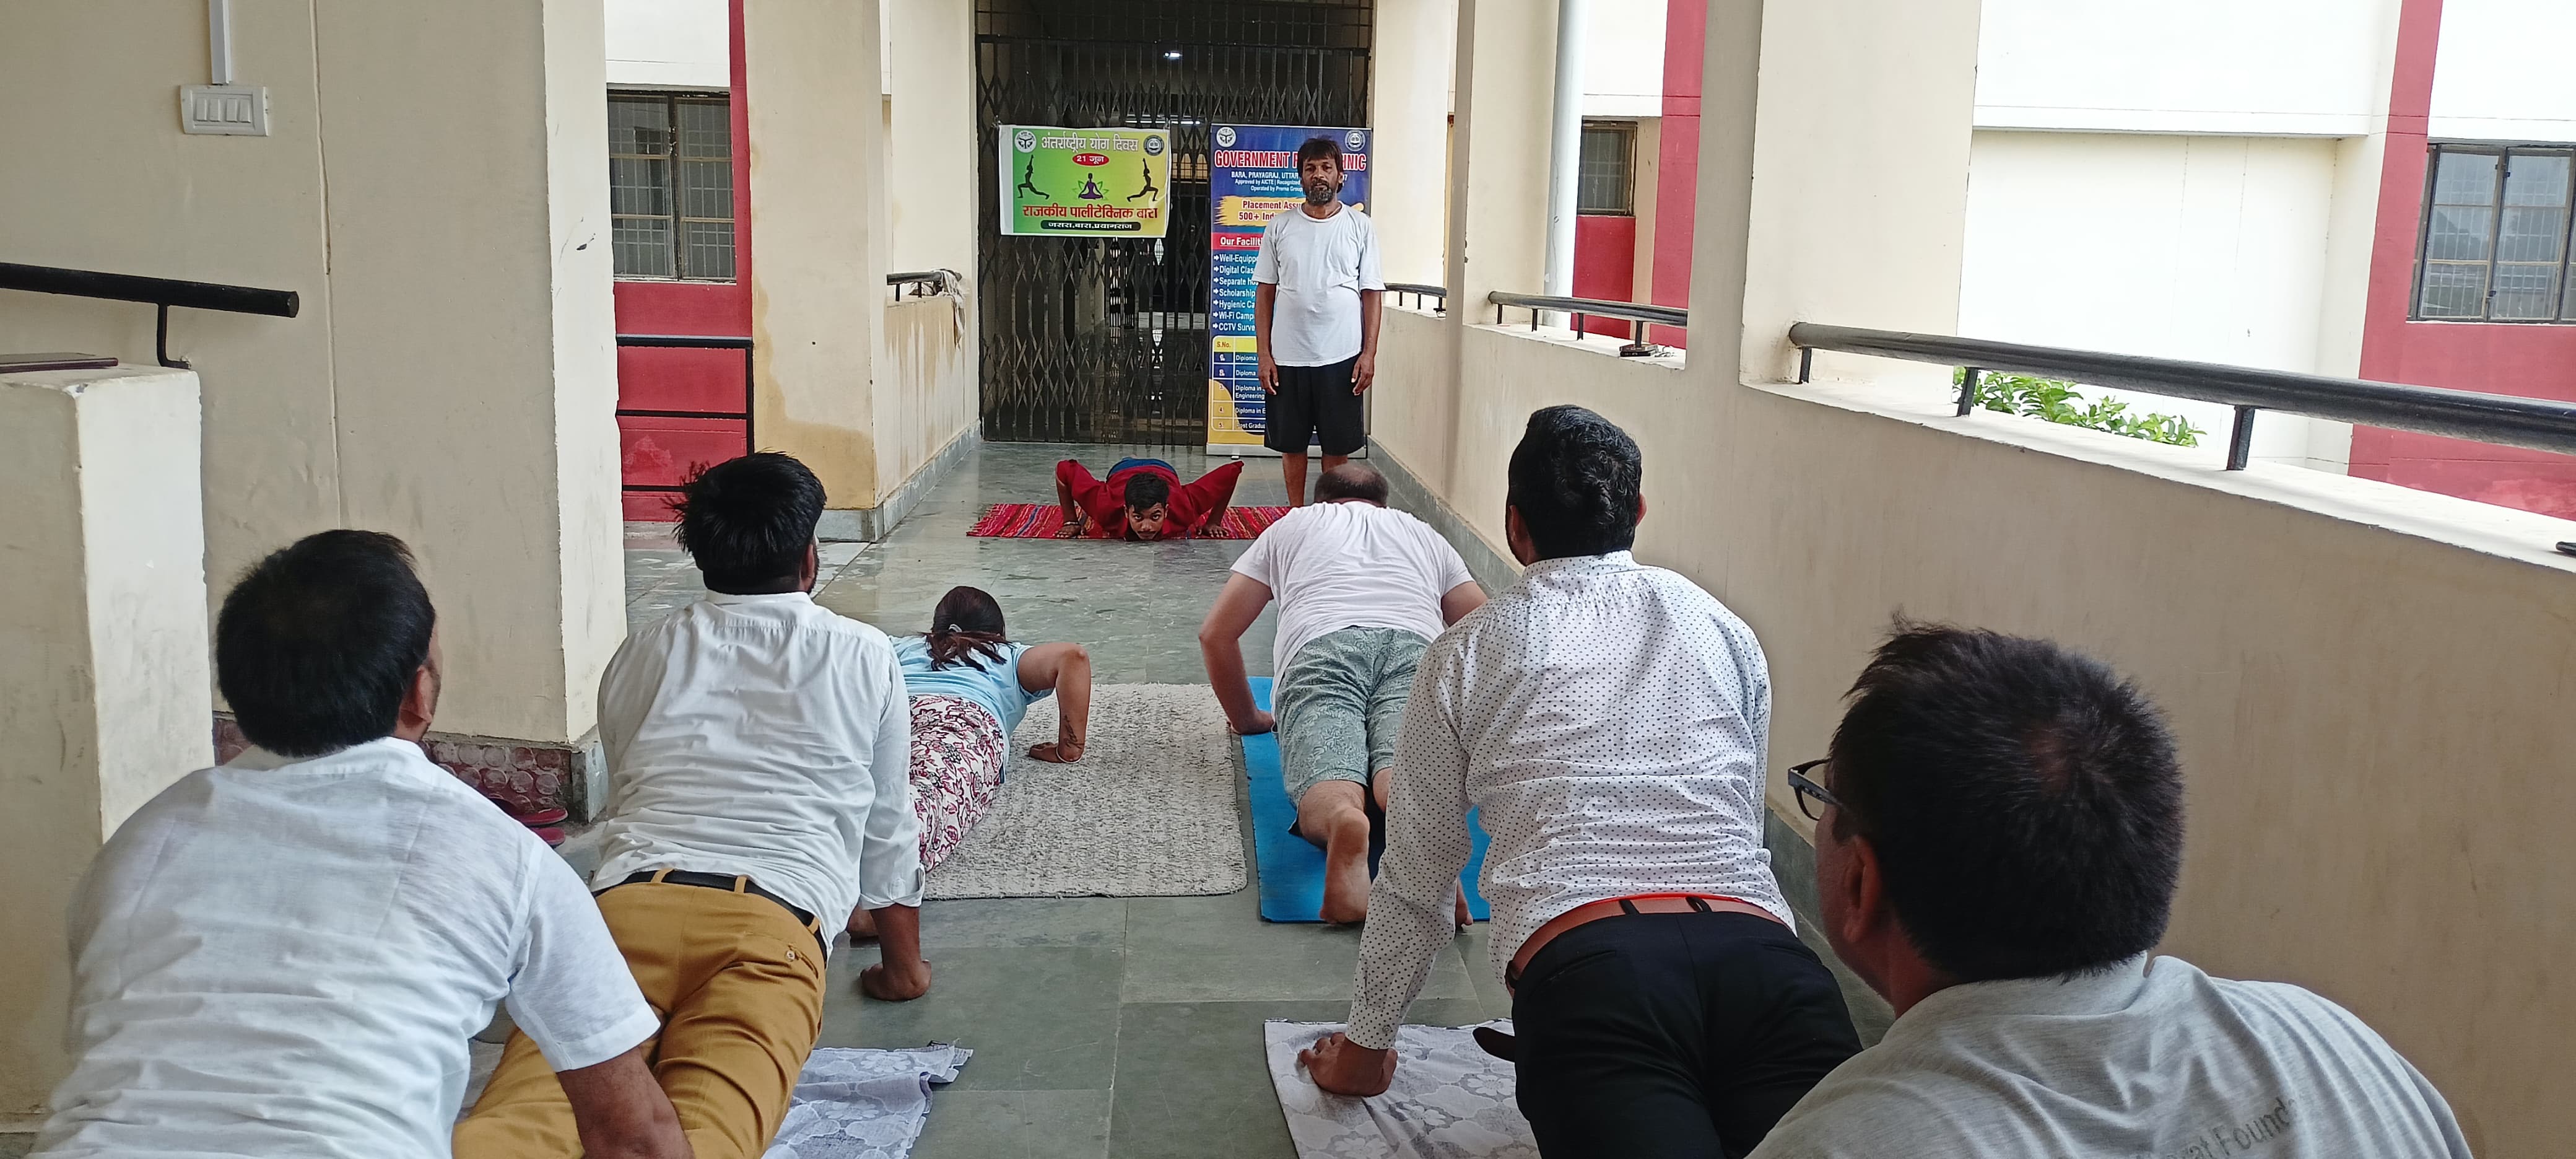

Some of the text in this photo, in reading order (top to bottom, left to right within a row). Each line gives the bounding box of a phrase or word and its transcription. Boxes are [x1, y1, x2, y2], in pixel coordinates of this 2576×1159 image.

[1090, 132, 1110, 150] योग
[1113, 133, 1139, 151] दिवस
[1089, 155, 1104, 164] जून
[1215, 150, 1290, 168] GOVERNMENT
[1243, 200, 1281, 209] Placement
[1023, 203, 1067, 217] राजकीय
[1136, 208, 1158, 219] बारा
[1238, 212, 1260, 221] 500+
[1221, 237, 1234, 245] Our
[1219, 253, 1258, 264] Well-Equipp
[1219, 265, 1239, 276] Digital
[1219, 277, 1246, 287] Separate
[1219, 300, 1245, 310] Hygienic
[1219, 311, 1235, 320] Wi-Fi
[1219, 323, 1236, 331] CCTV
